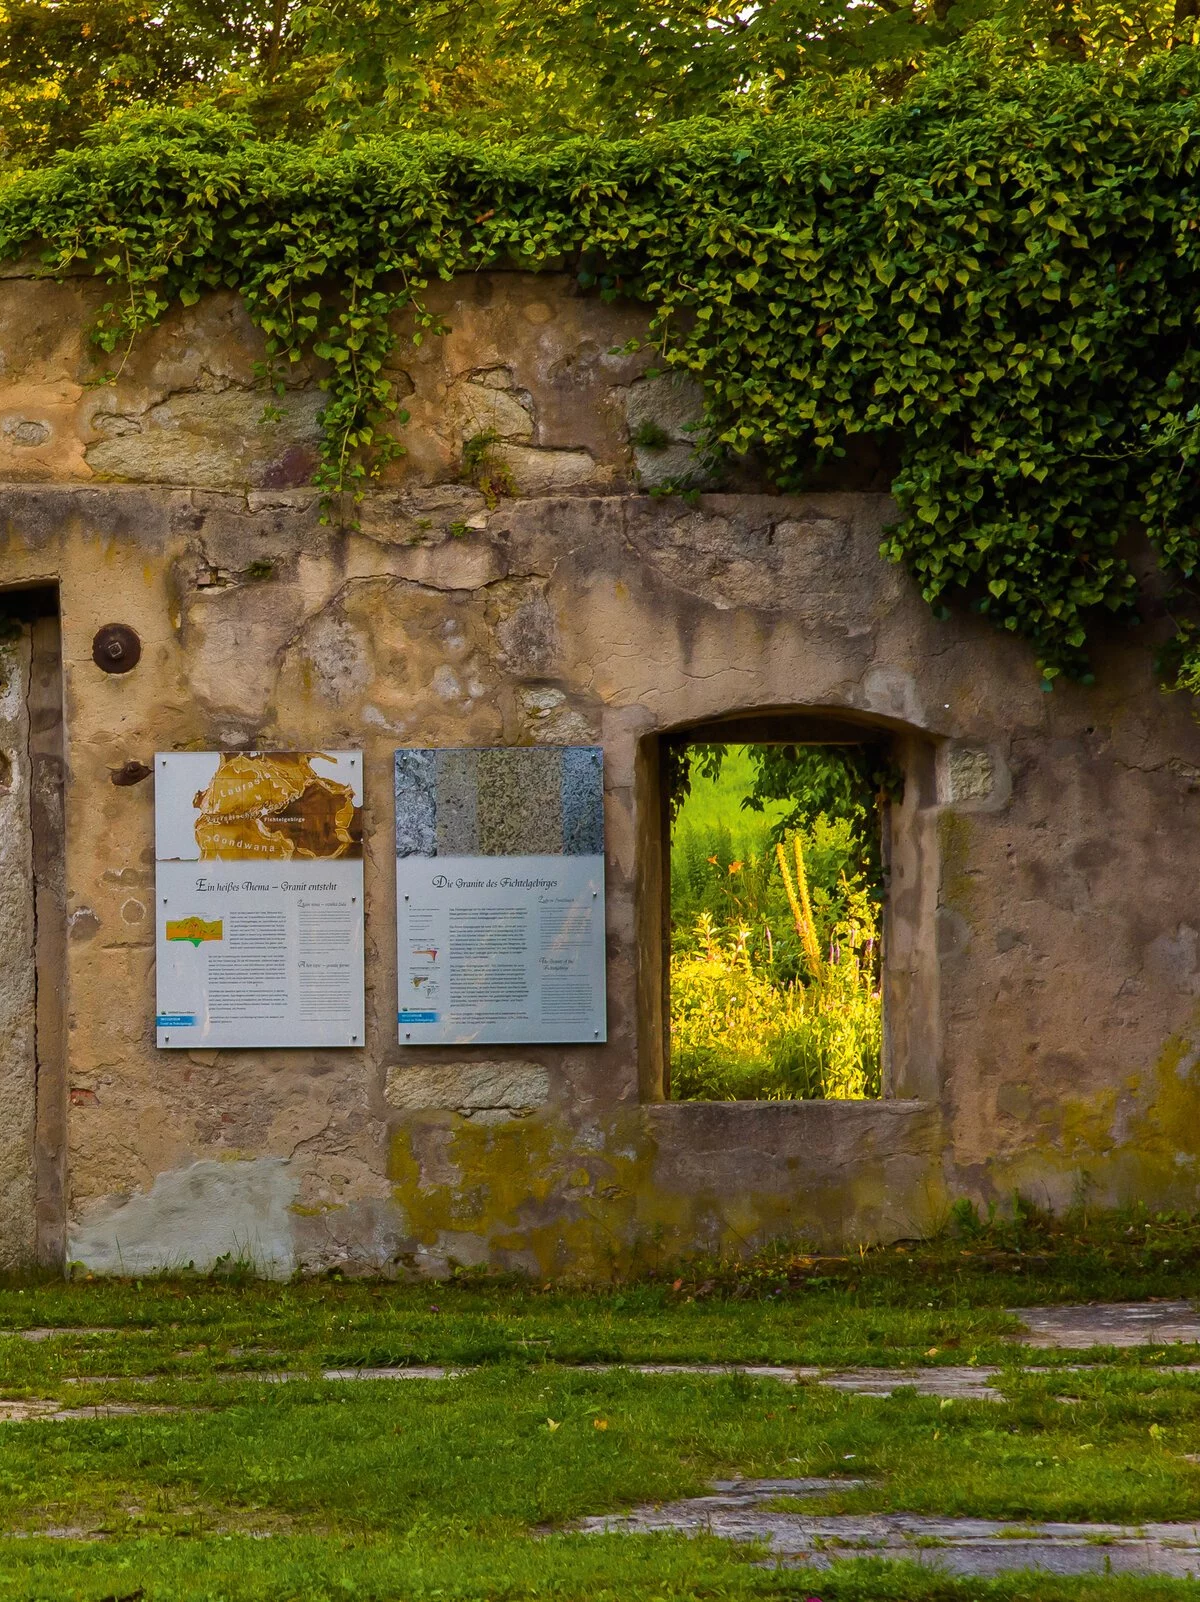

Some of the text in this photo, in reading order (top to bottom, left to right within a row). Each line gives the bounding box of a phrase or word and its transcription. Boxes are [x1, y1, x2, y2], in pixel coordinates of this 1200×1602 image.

[213, 833, 275, 852] Gondwana
[195, 878, 215, 892] Ein
[216, 882, 239, 893] heißes
[241, 881, 270, 892] Thema
[280, 881, 306, 893] Granit
[308, 882, 337, 891] entsteht
[432, 875, 558, 890] Die Granite des Fichtelgebirges
